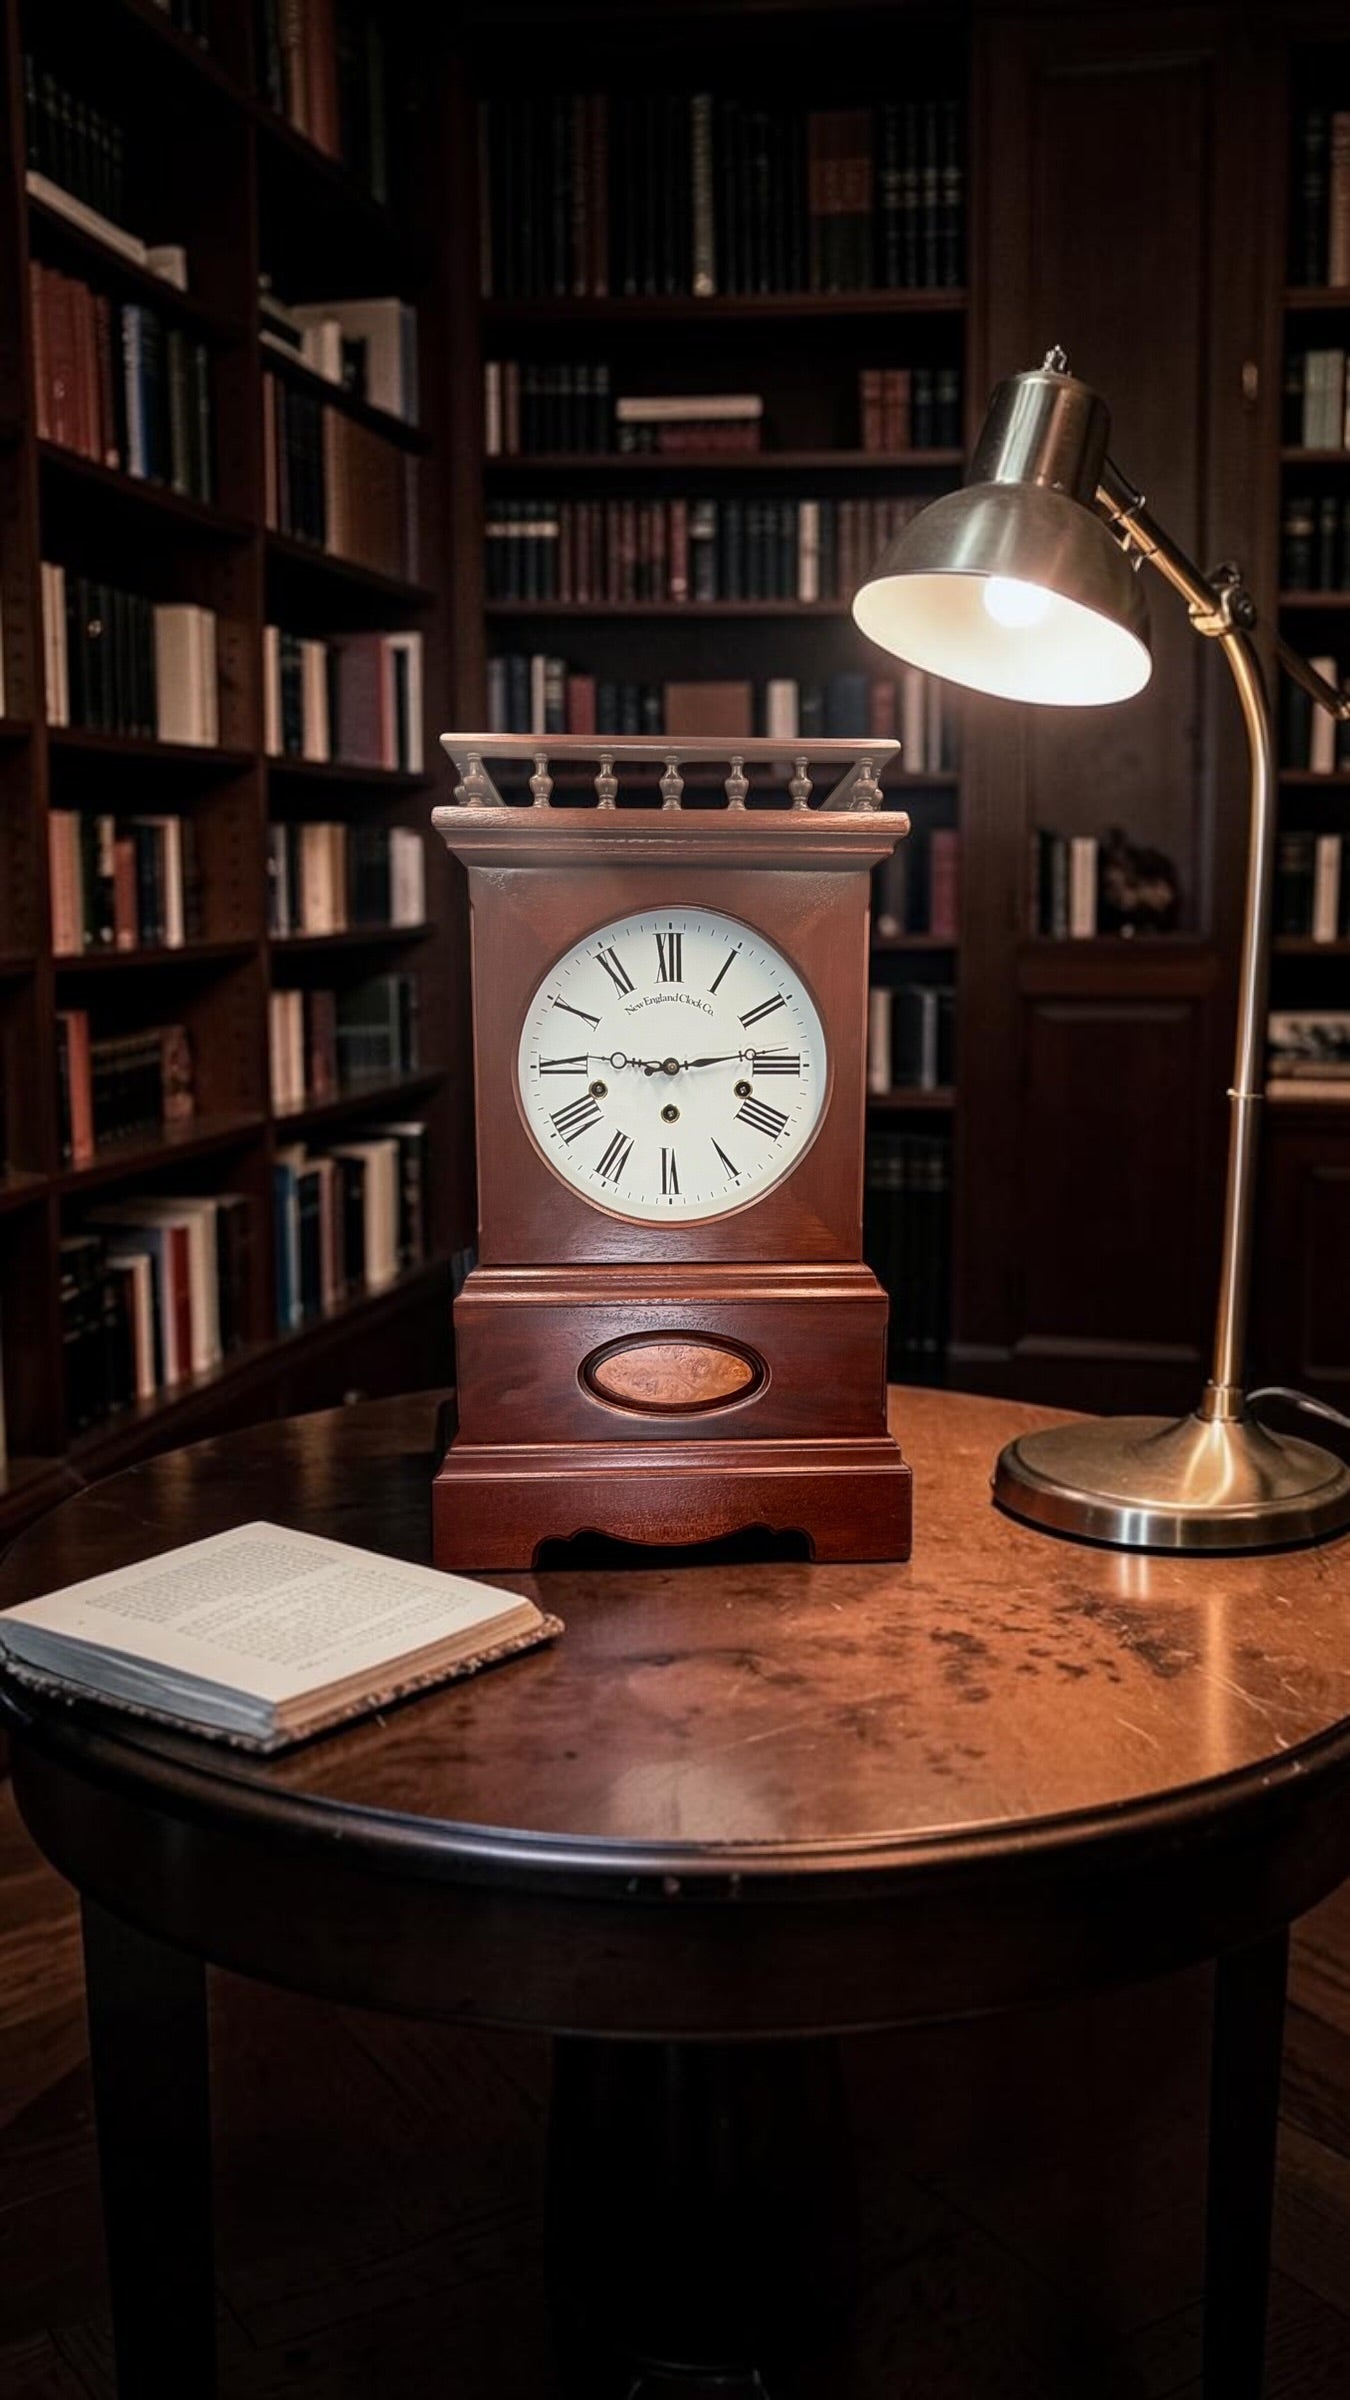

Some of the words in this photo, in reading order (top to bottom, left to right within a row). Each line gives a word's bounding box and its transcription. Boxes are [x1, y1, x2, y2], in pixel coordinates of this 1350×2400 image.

[593, 946, 638, 1000] XI
[653, 932, 685, 983] XII
[707, 948, 741, 996] I
[552, 994, 603, 1032] X
[624, 1001, 643, 1015] New
[643, 993, 679, 1006] England
[679, 993, 702, 1009] Clock
[702, 1003, 714, 1016] Co.
[737, 991, 788, 1030] II
[539, 1052, 589, 1078] IX
[752, 1054, 801, 1076] III
[549, 1094, 605, 1146] VIII
[734, 1096, 791, 1140] IIII
[593, 1128, 635, 1185] VII
[659, 1147, 680, 1195] VI
[710, 1136, 742, 1182] V
